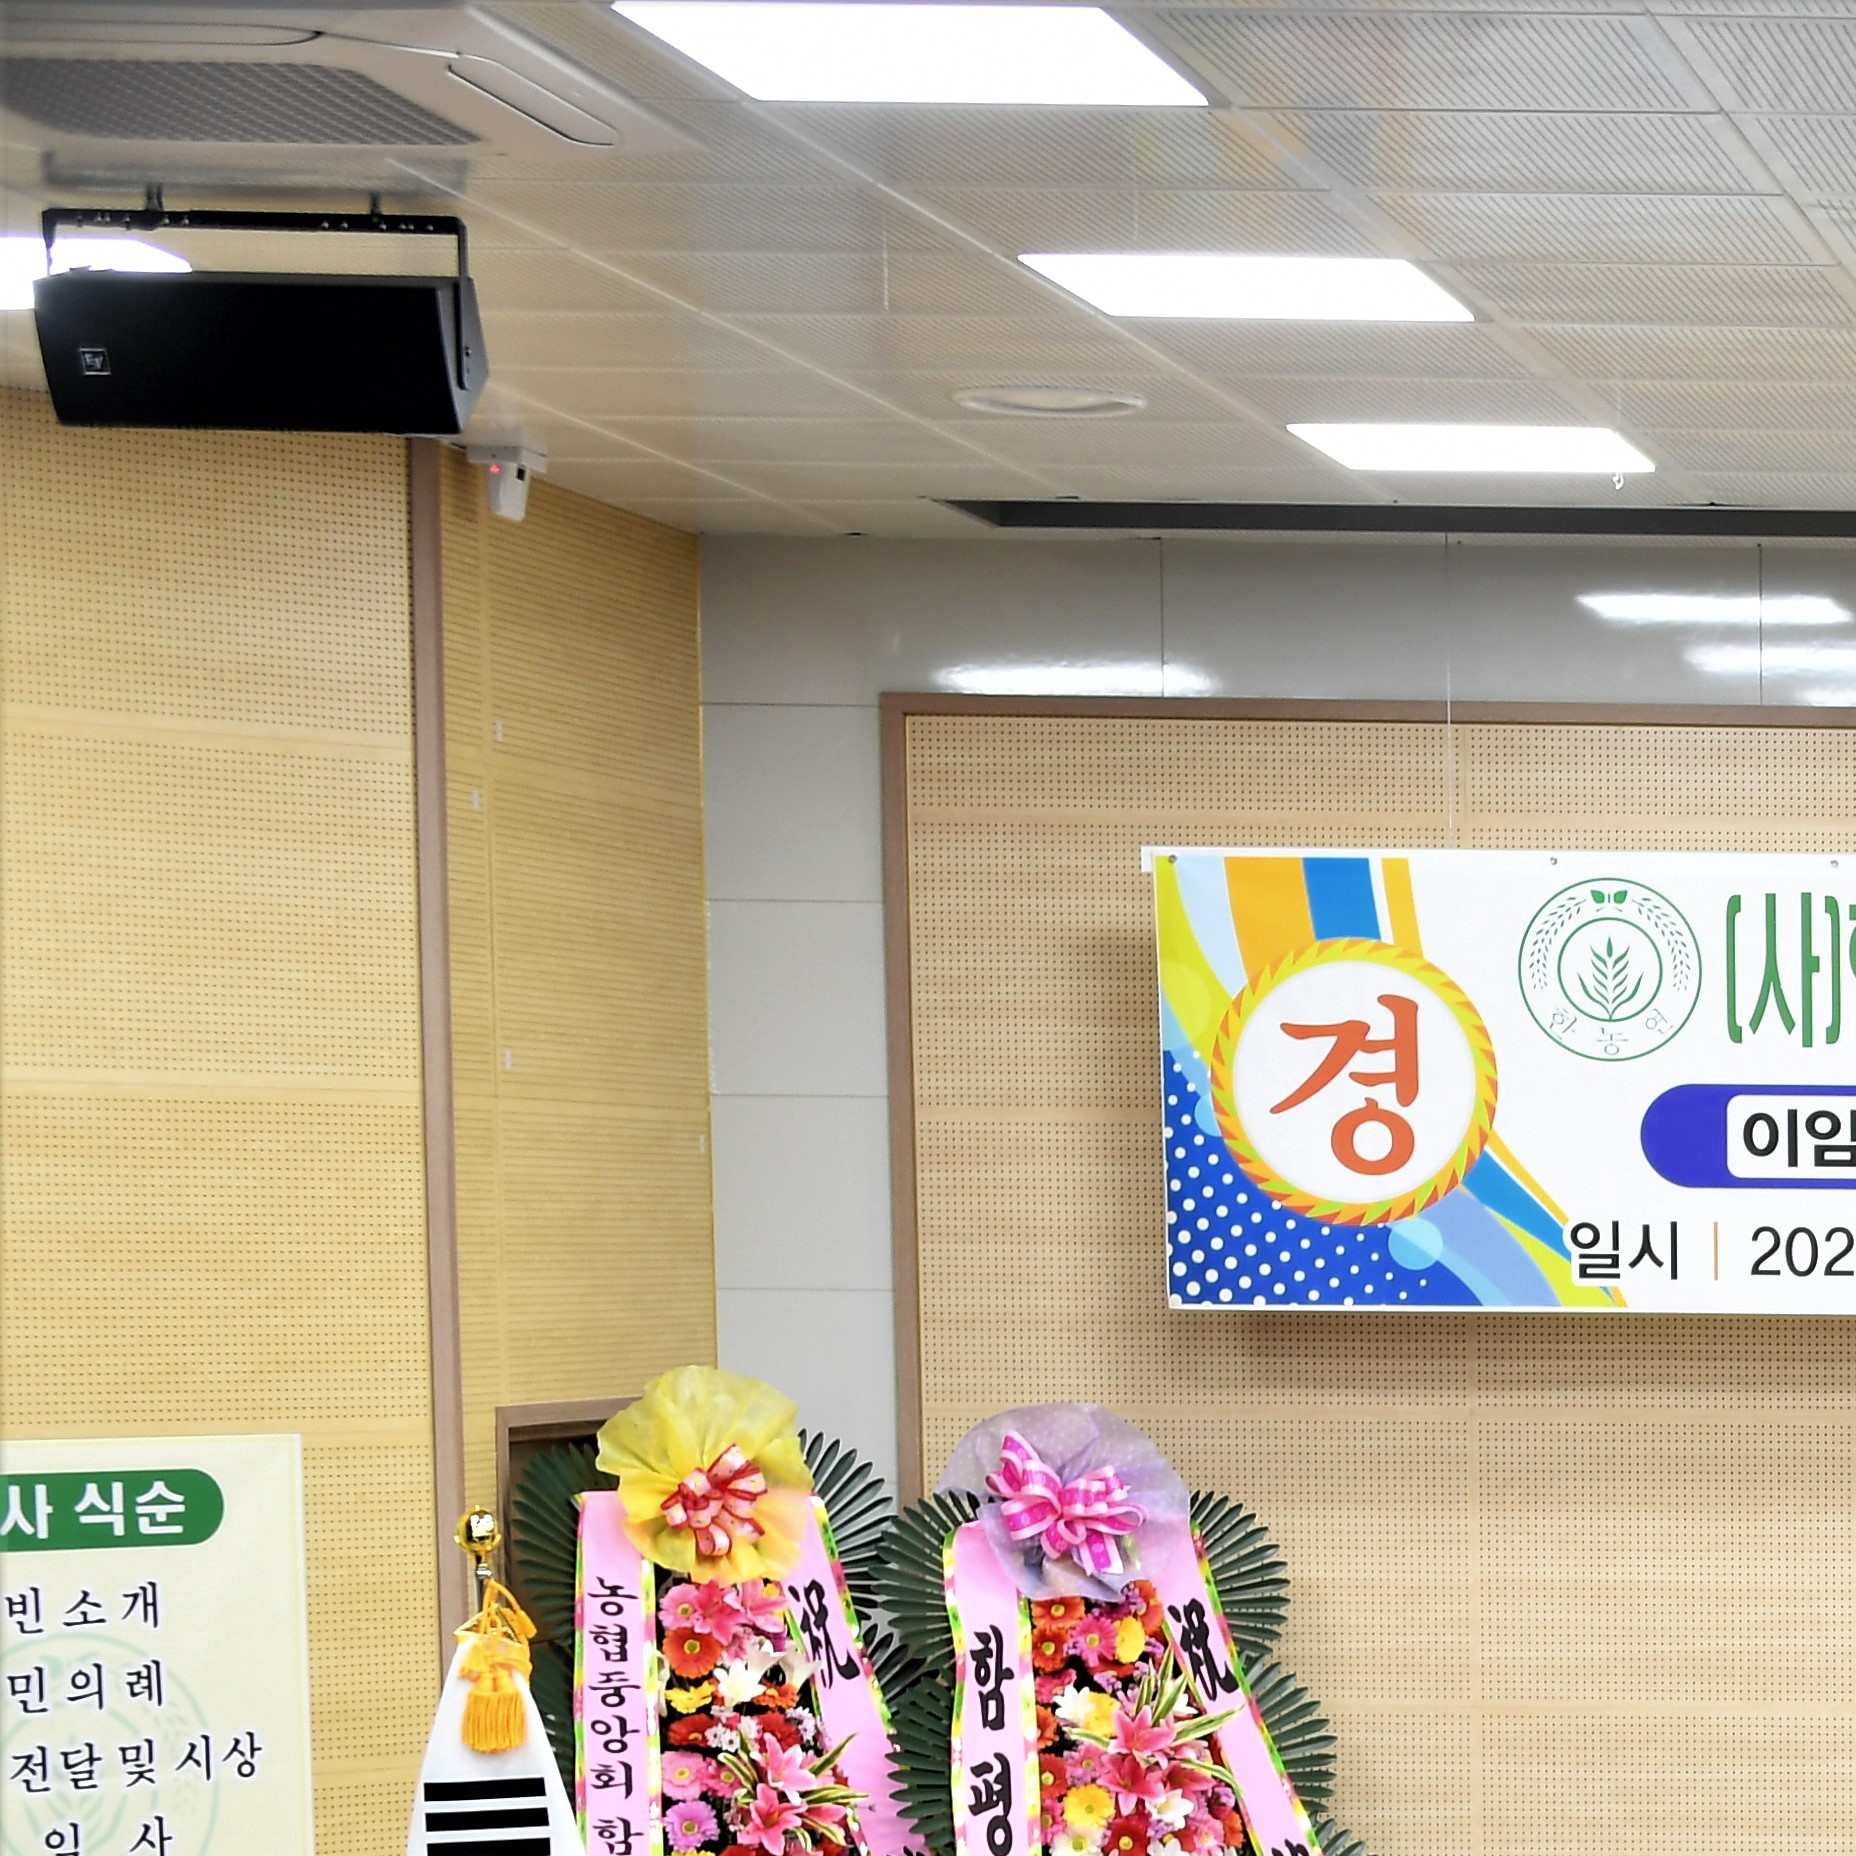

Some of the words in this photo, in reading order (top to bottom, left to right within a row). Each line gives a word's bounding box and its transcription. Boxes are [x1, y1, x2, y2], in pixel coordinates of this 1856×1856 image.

[1272, 994, 1419, 1176] 경
[1570, 1220, 1678, 1280] 일시
[74, 1480, 186, 1536] 식순
[587, 1576, 642, 1800] 농협중앙회
[10, 1742, 103, 1793] 전달
[118, 1738, 156, 1787] 및
[175, 1731, 263, 1781] 시상
